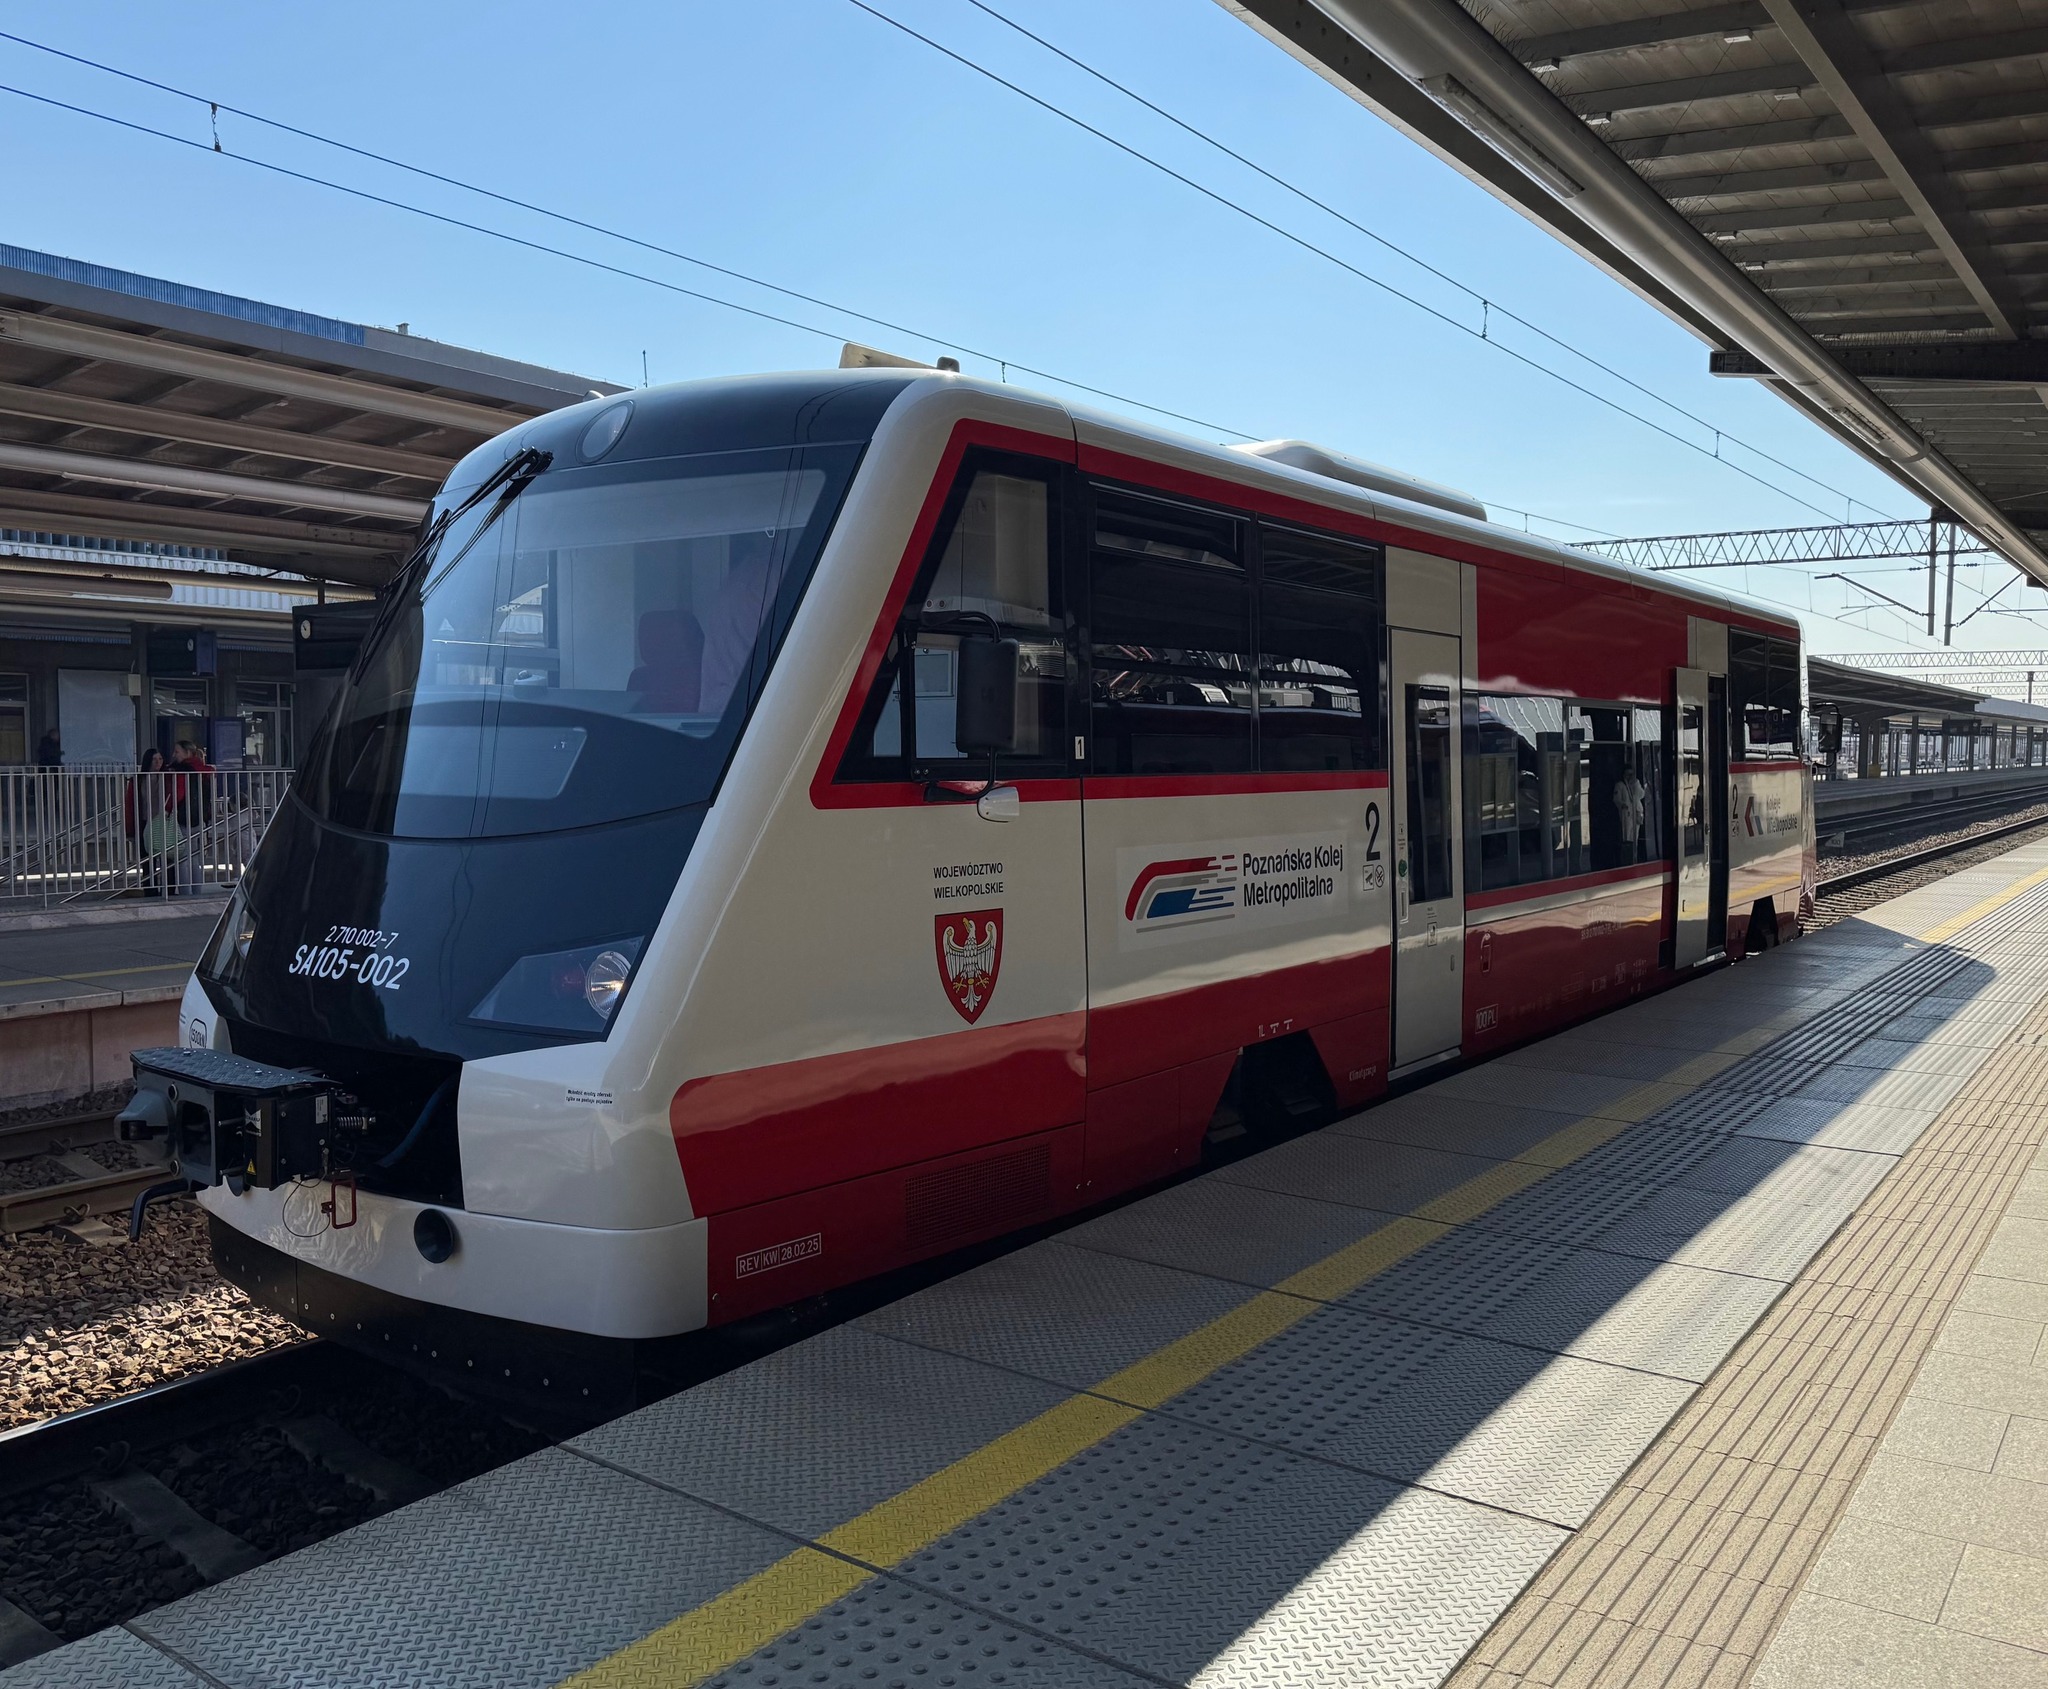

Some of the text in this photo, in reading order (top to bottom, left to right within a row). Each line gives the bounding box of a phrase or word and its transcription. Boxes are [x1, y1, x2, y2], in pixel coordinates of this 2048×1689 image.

[1077, 738, 1083, 757] 1
[1732, 783, 1739, 819] 2
[1365, 801, 1381, 862] 2
[933, 862, 1003, 879] WOJEWÓDZTWO
[1242, 844, 1343, 877] Poznańska Kolej
[934, 881, 1004, 899] WIELKOPOLSKIE
[1243, 874, 1334, 907] Metropolitalna
[288, 944, 410, 990] SA105-002
[739, 1238, 819, 1274] REV KW 28.02.25
